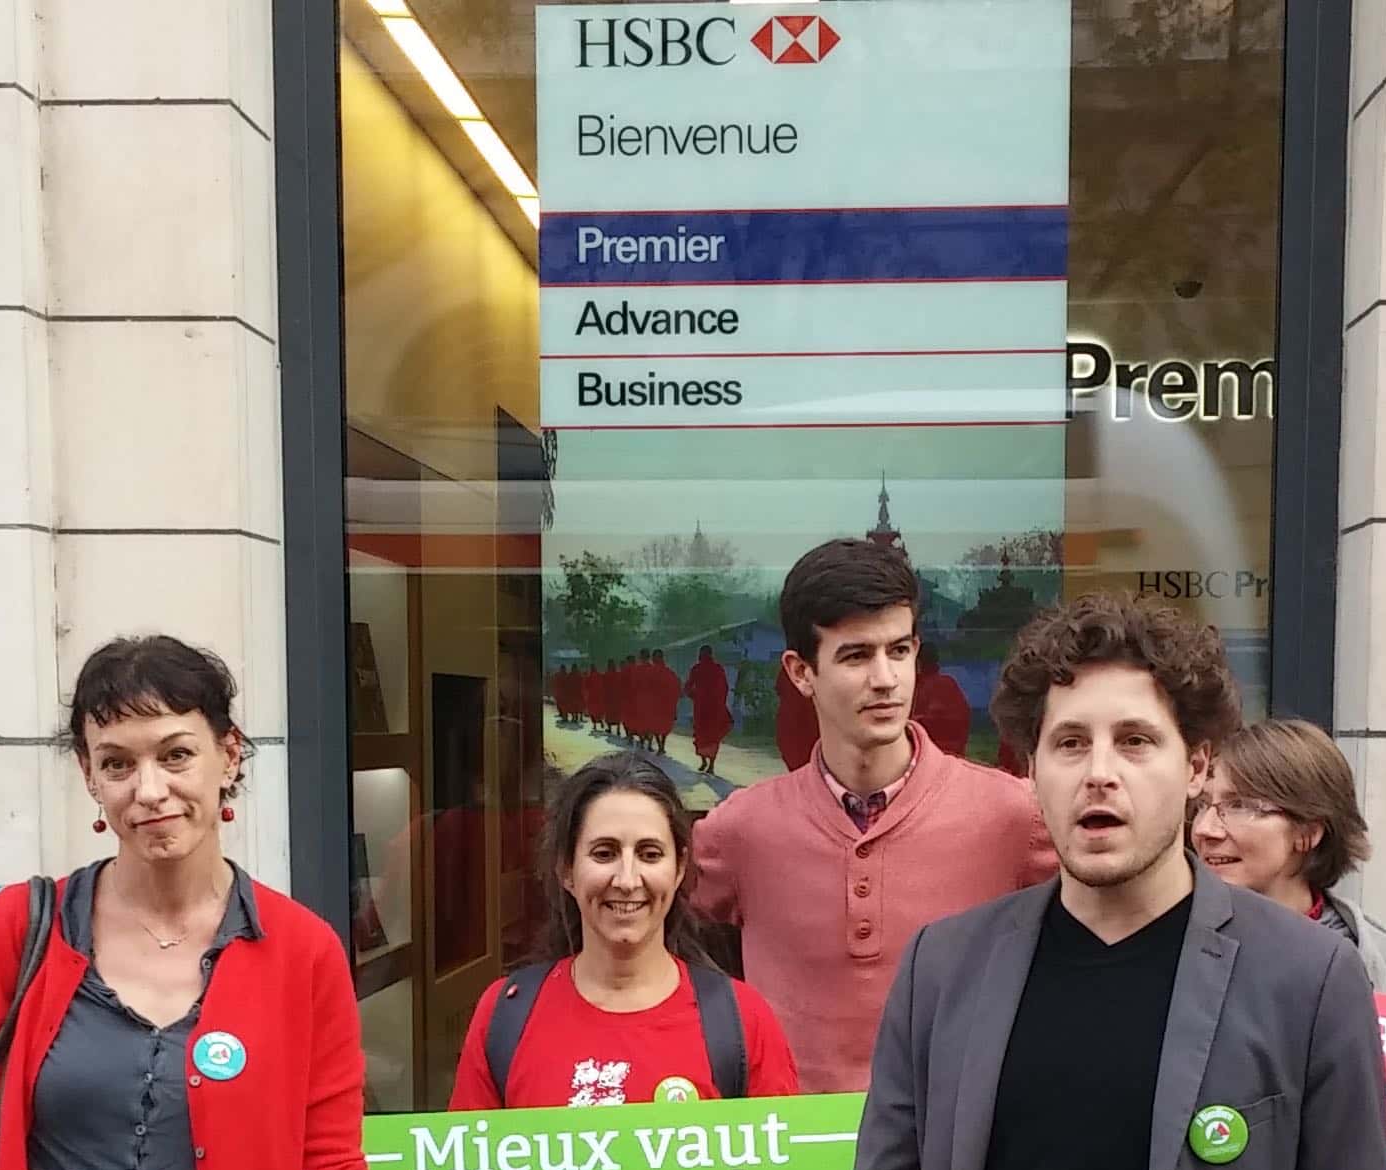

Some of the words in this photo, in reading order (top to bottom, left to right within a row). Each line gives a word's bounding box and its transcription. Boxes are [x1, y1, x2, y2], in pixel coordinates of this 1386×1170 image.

[575, 15, 737, 68] HSBC
[577, 113, 798, 156] Bienvenue
[576, 226, 725, 264] Premier
[575, 301, 739, 336] Advance
[577, 371, 742, 407] Business
[1065, 337, 1276, 422] Prem
[1138, 571, 1230, 599] HSBC
[634, 1113, 790, 1168] vaut
